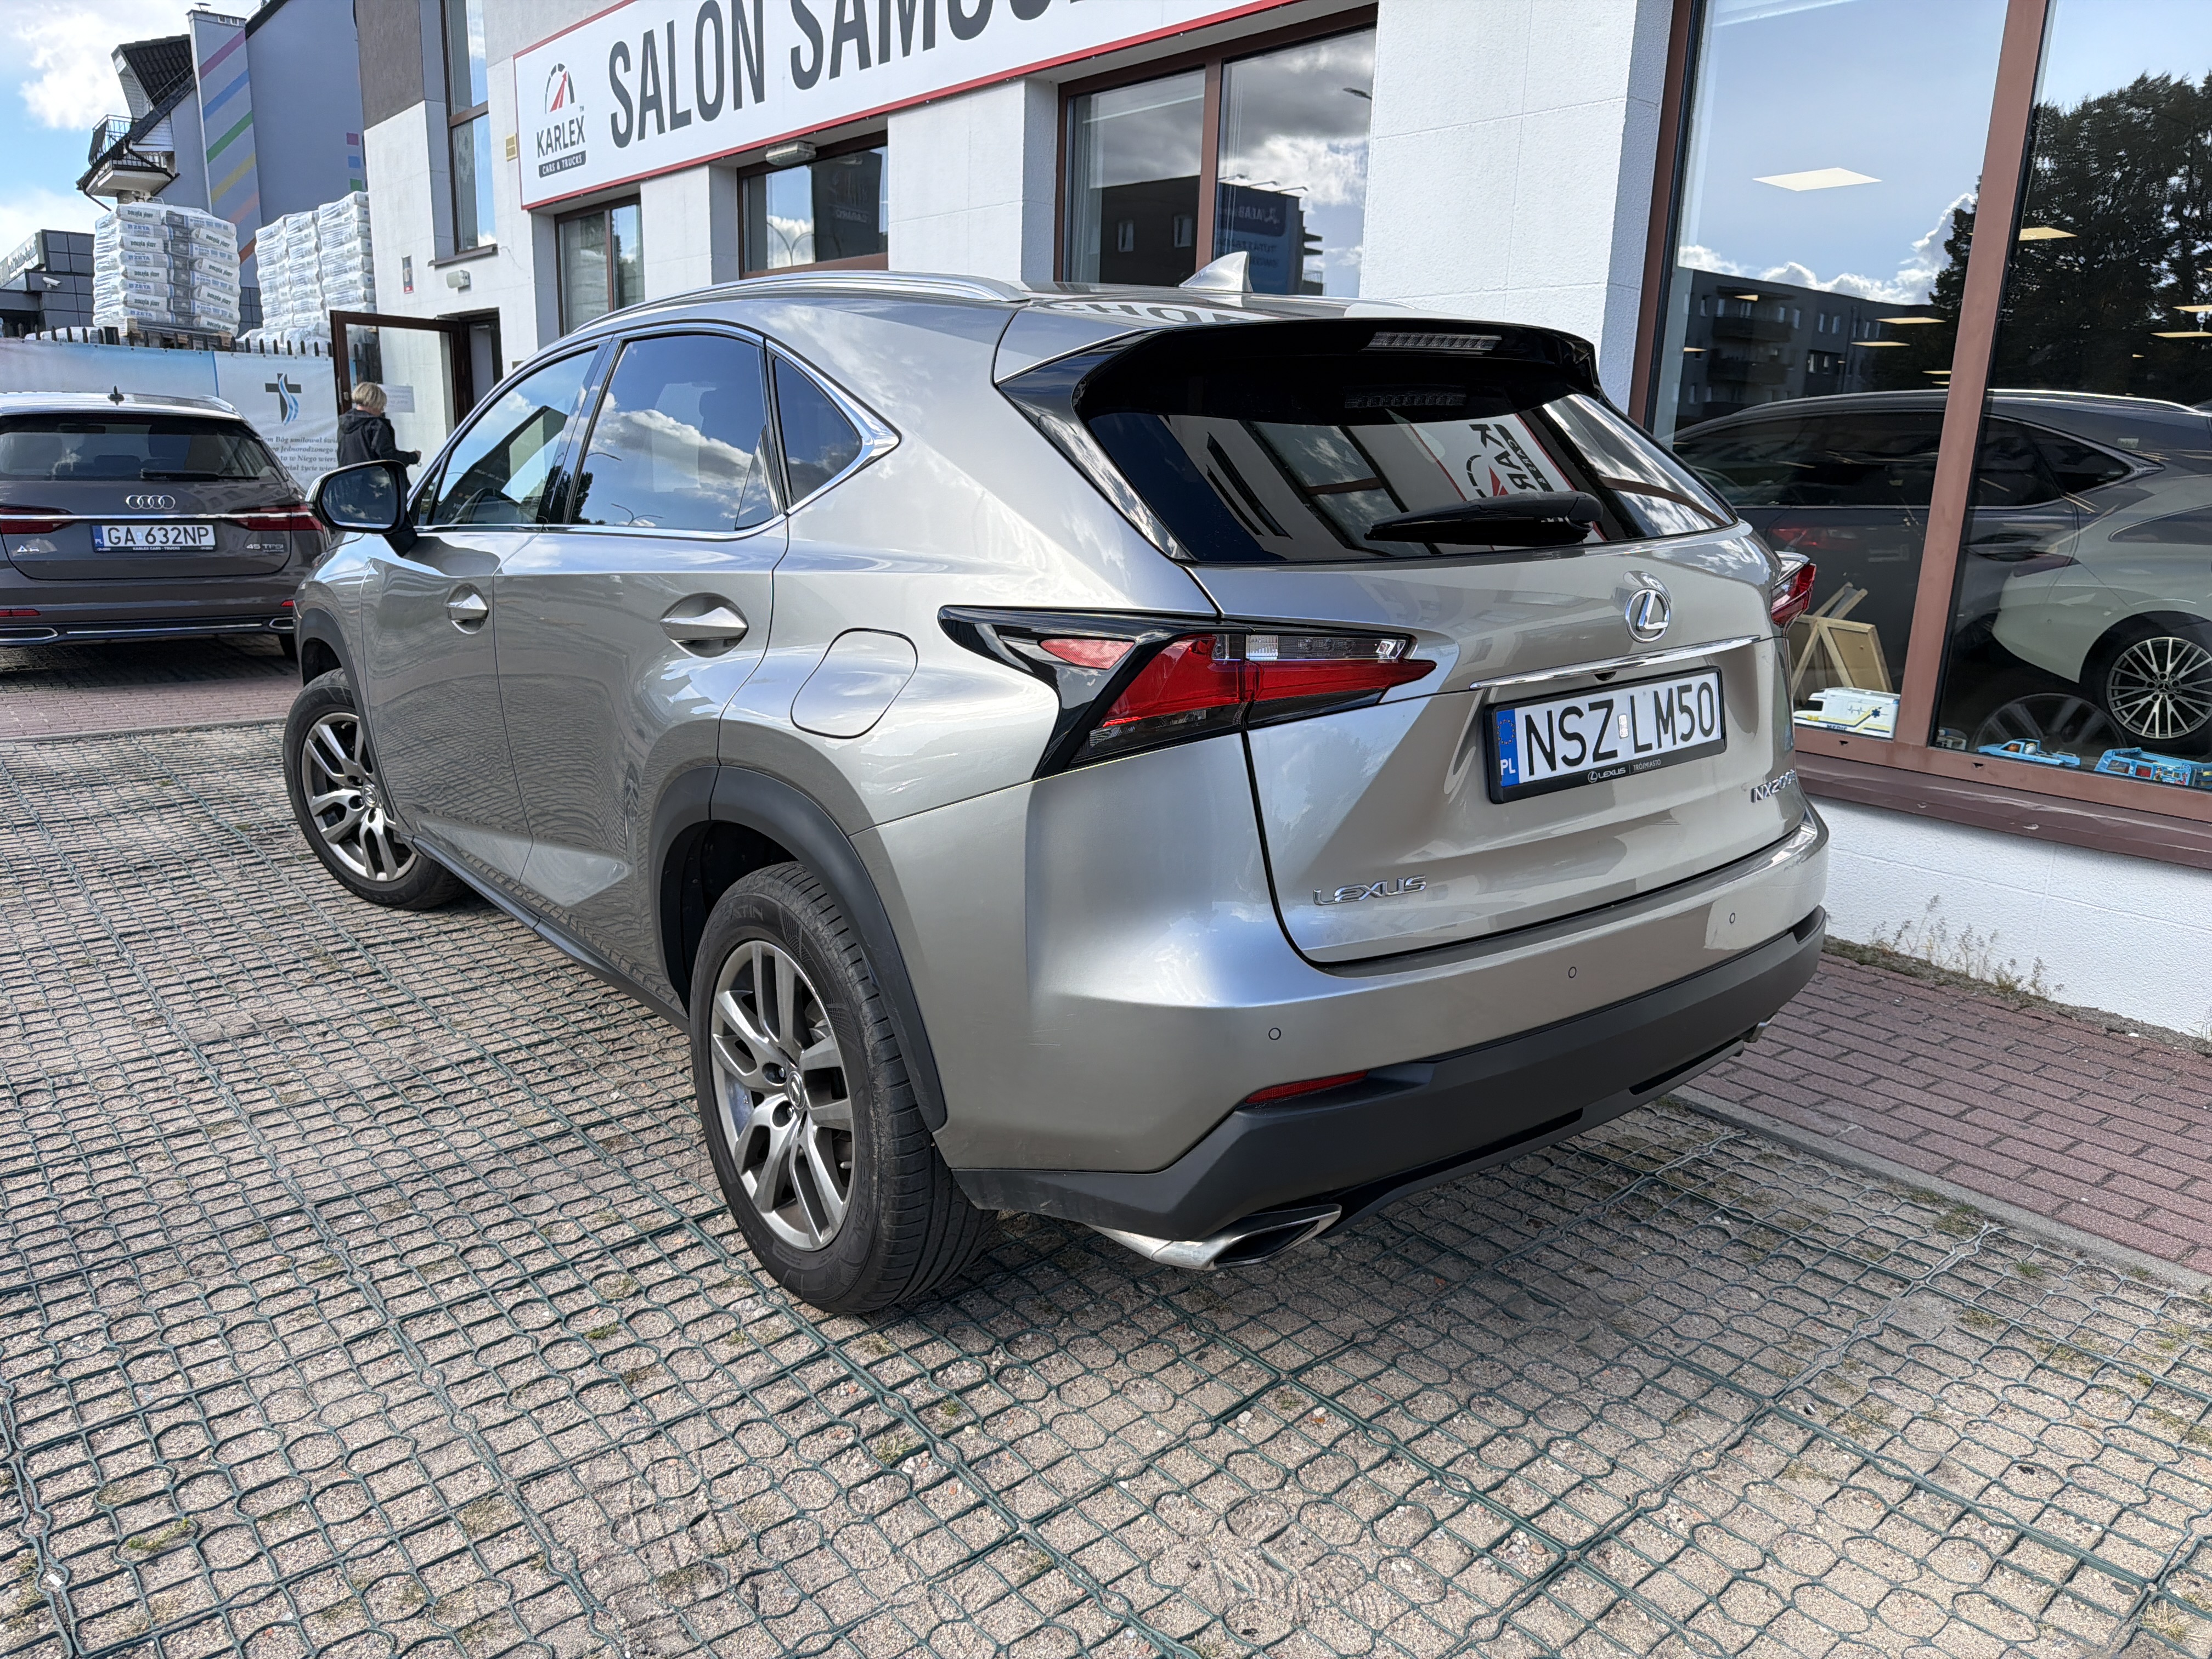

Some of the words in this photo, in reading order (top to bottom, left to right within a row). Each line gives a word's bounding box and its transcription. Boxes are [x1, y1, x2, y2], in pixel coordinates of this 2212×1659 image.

[609, 0, 765, 148] SALON
[537, 115, 585, 158] KARLEX
[542, 162, 555, 174] CARS
[561, 154, 582, 168] TRUCKS
[108, 527, 137, 545] GA
[145, 527, 209, 545] 632NP
[1500, 758, 1516, 776] PL
[1525, 698, 1618, 777] NSZ
[1629, 681, 1715, 754] LM50
[1598, 767, 1626, 779] LEXUS
[1633, 759, 1662, 771] TRÓJMIASTO
[1312, 874, 1426, 906] LEXUS
